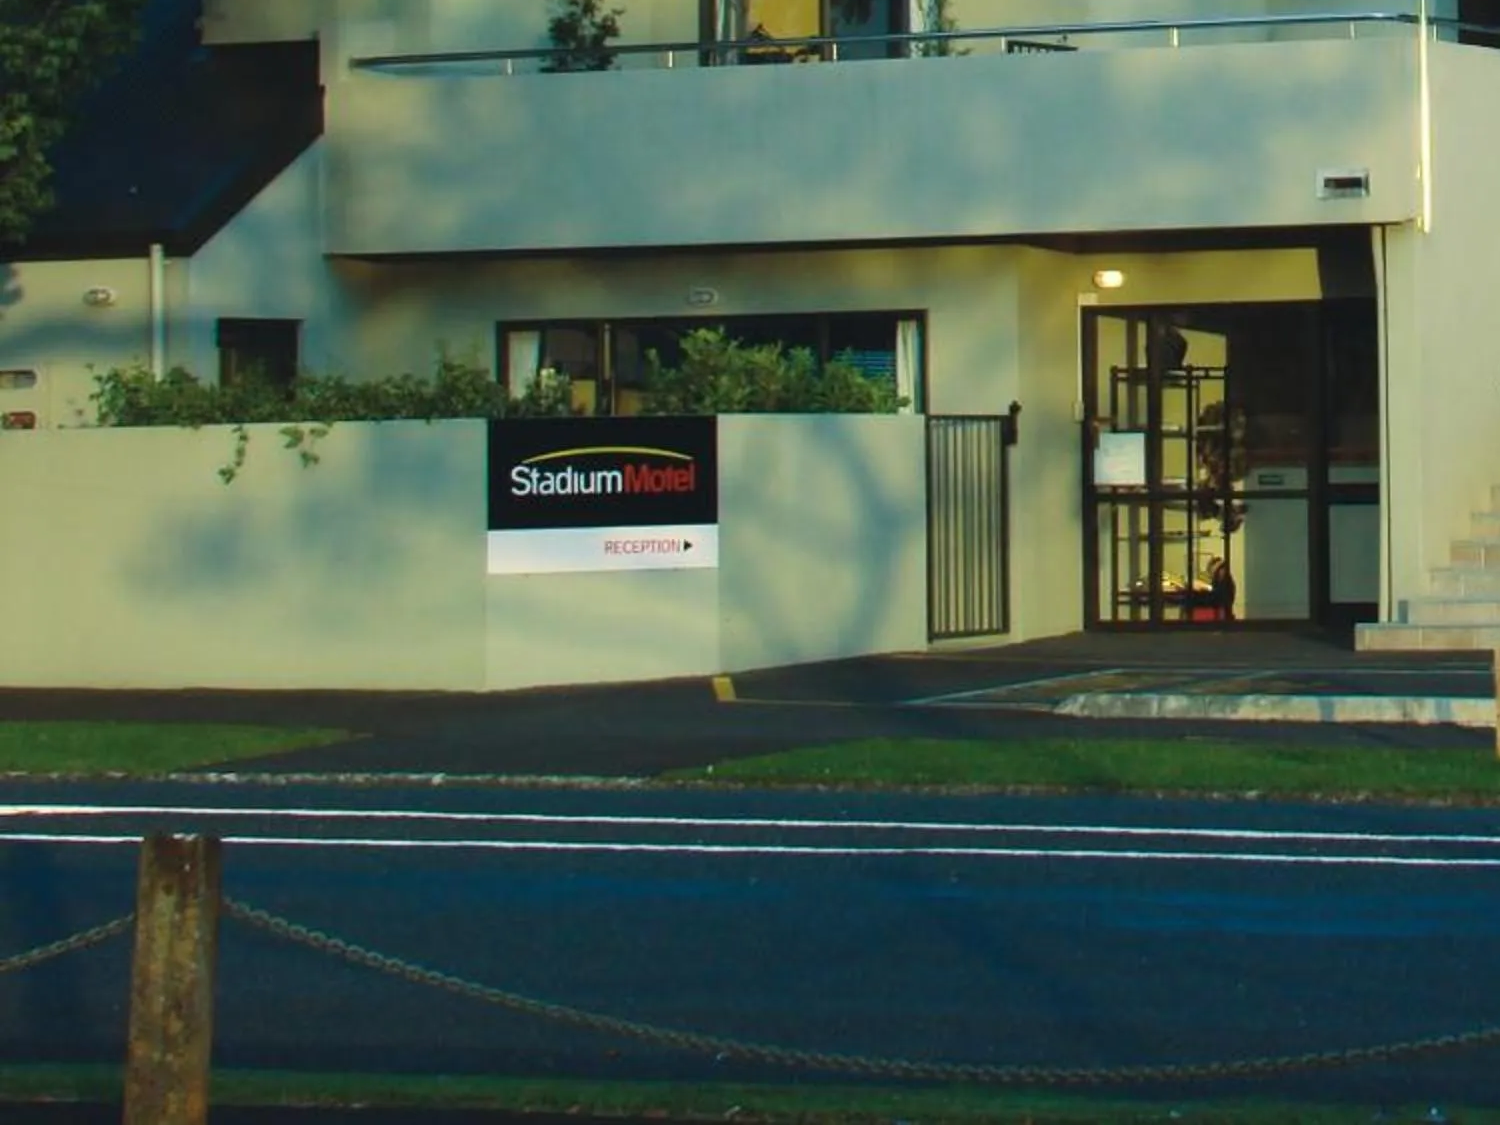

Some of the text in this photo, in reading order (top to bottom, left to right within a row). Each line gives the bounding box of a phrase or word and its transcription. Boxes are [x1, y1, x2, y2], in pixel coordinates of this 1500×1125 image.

[511, 464, 695, 495] Stadium Motel
[605, 539, 680, 555] RECEPTION
